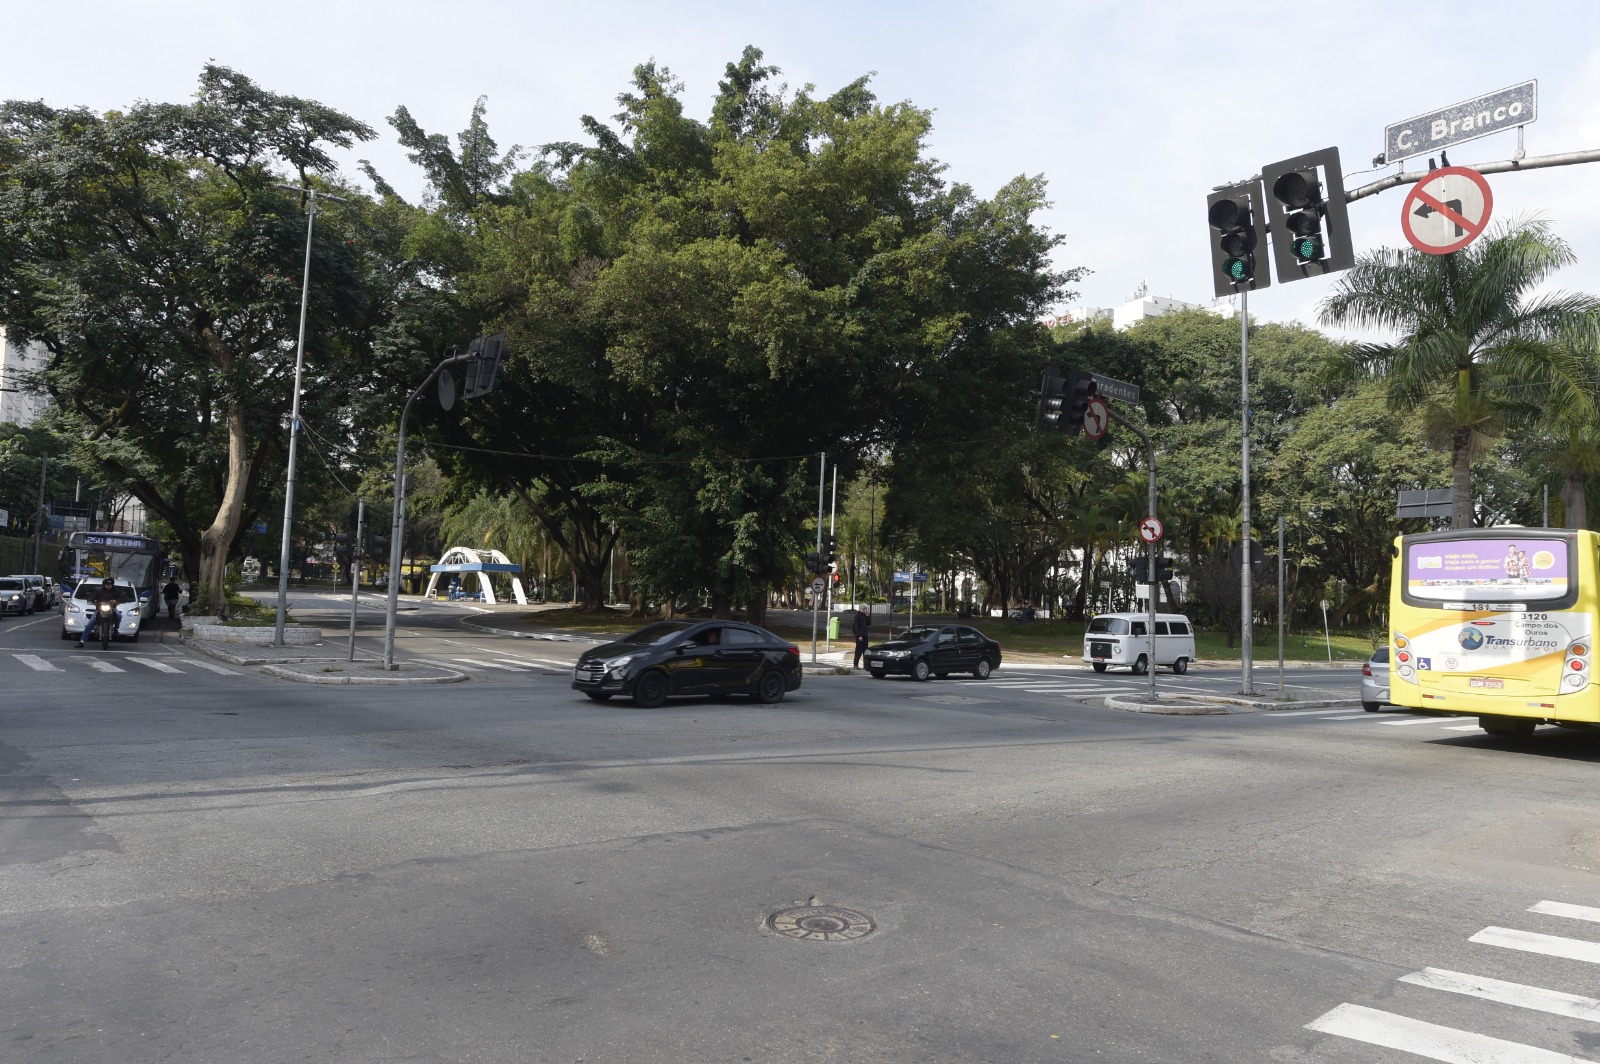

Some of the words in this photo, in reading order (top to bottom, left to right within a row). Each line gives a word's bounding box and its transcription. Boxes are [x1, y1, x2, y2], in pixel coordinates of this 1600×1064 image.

[1397, 129, 1419, 150] C.
[1431, 102, 1523, 141] Branco
[1096, 380, 1137, 400] iradentes
[114, 538, 141, 548] PENHA
[1515, 621, 1542, 629] Campo
[1485, 635, 1558, 648] Transurbano
